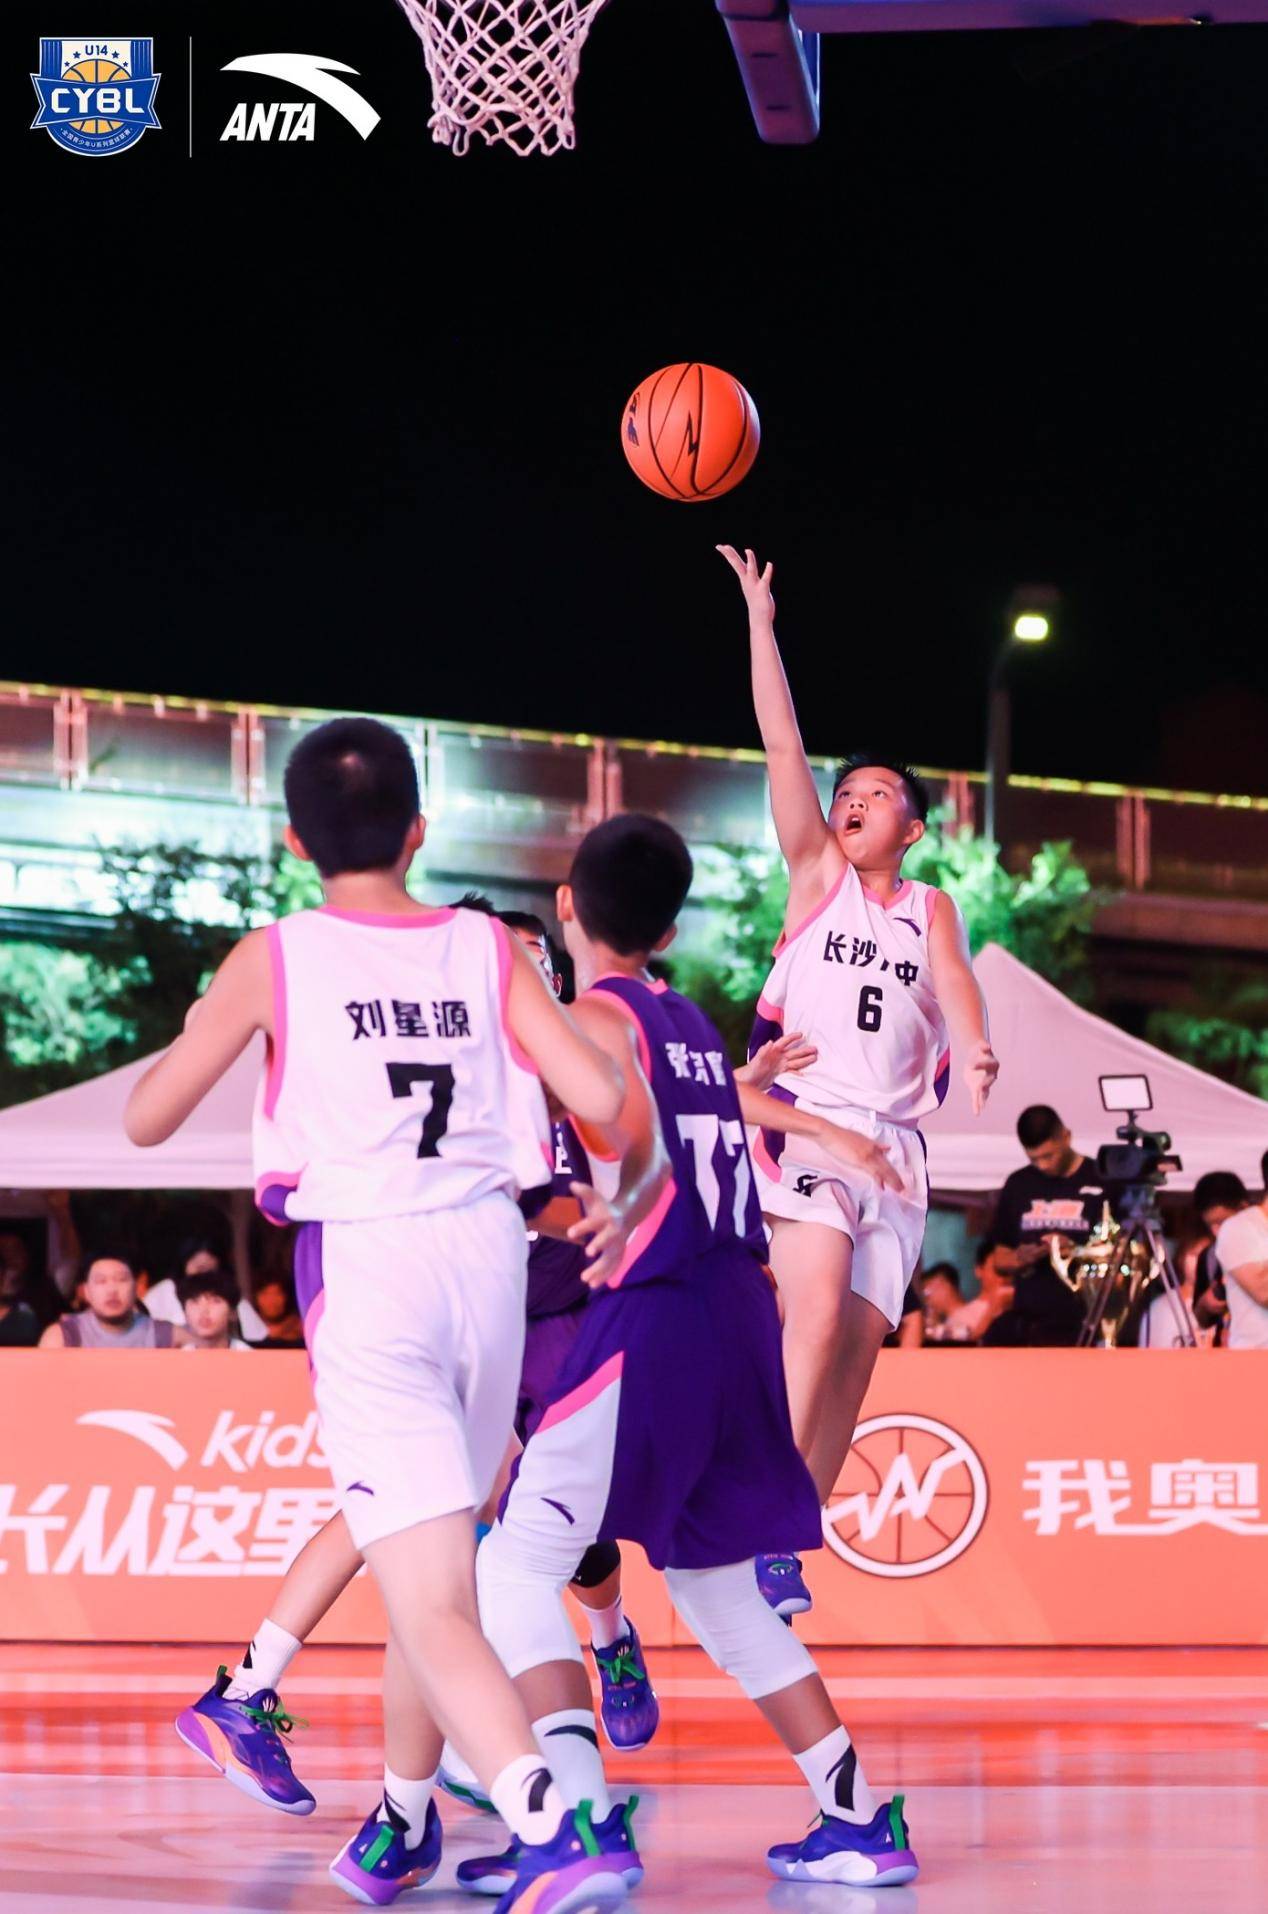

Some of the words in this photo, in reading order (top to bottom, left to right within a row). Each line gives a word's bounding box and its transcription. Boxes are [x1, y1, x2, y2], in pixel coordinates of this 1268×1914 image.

[823, 930, 919, 986] 长沙中
[345, 999, 471, 1040] 刘星源
[857, 985, 883, 1032] 6
[385, 1062, 455, 1158] 7
[676, 1113, 751, 1238] 77
